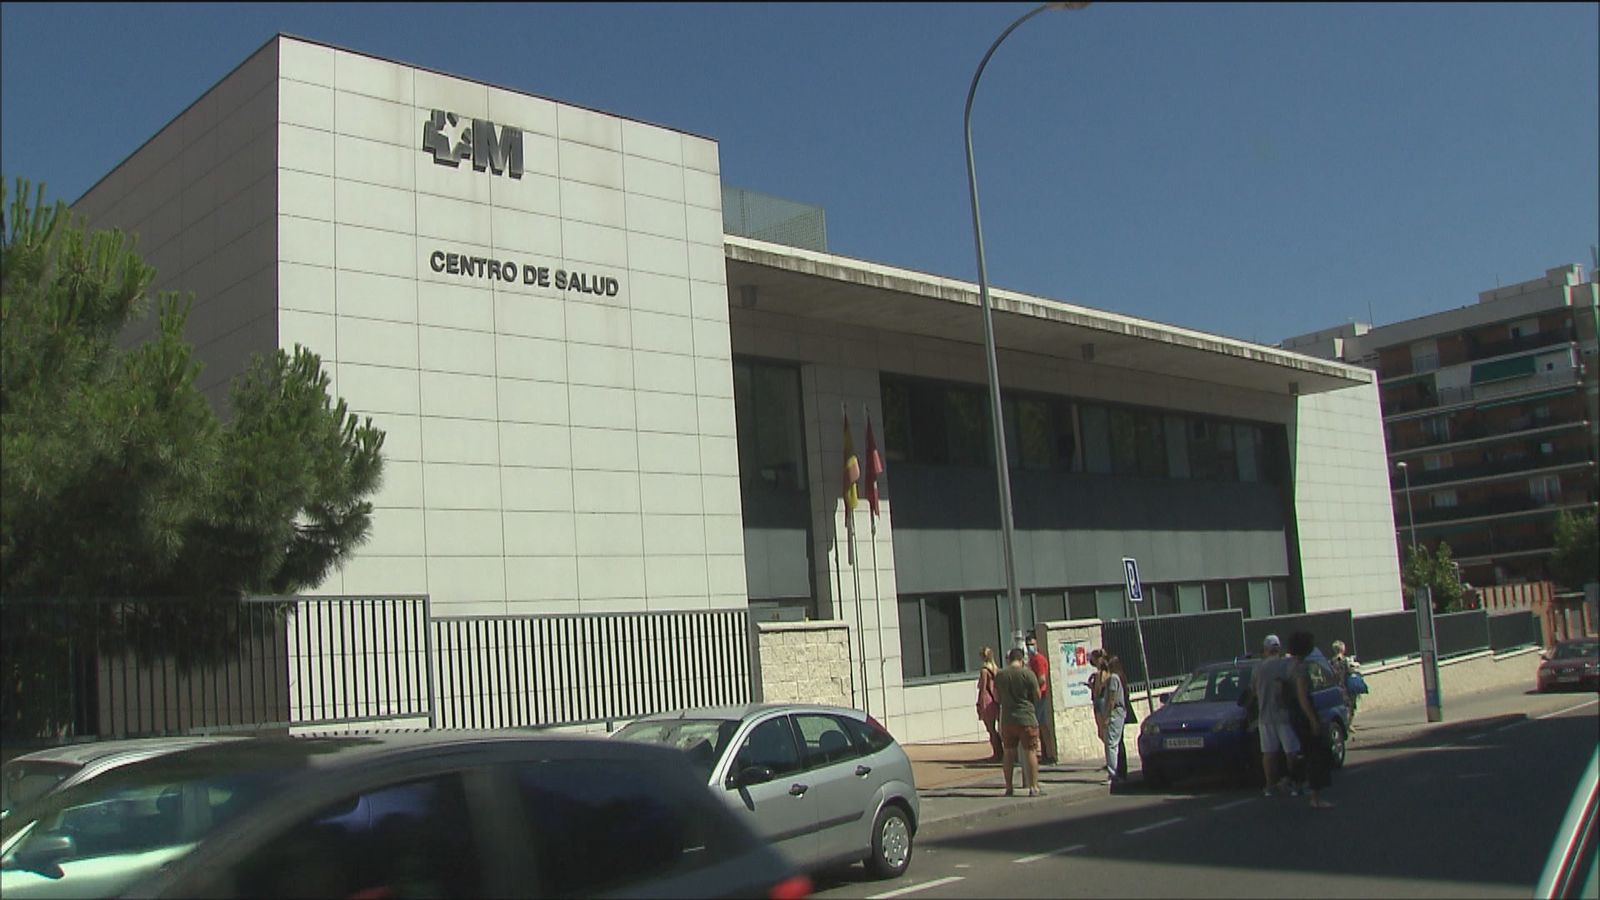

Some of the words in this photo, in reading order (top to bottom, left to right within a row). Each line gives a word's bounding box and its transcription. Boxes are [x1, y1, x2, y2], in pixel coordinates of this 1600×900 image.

[430, 250, 518, 283] CENTRO
[523, 265, 551, 288] DE
[555, 270, 619, 297] SALUD
